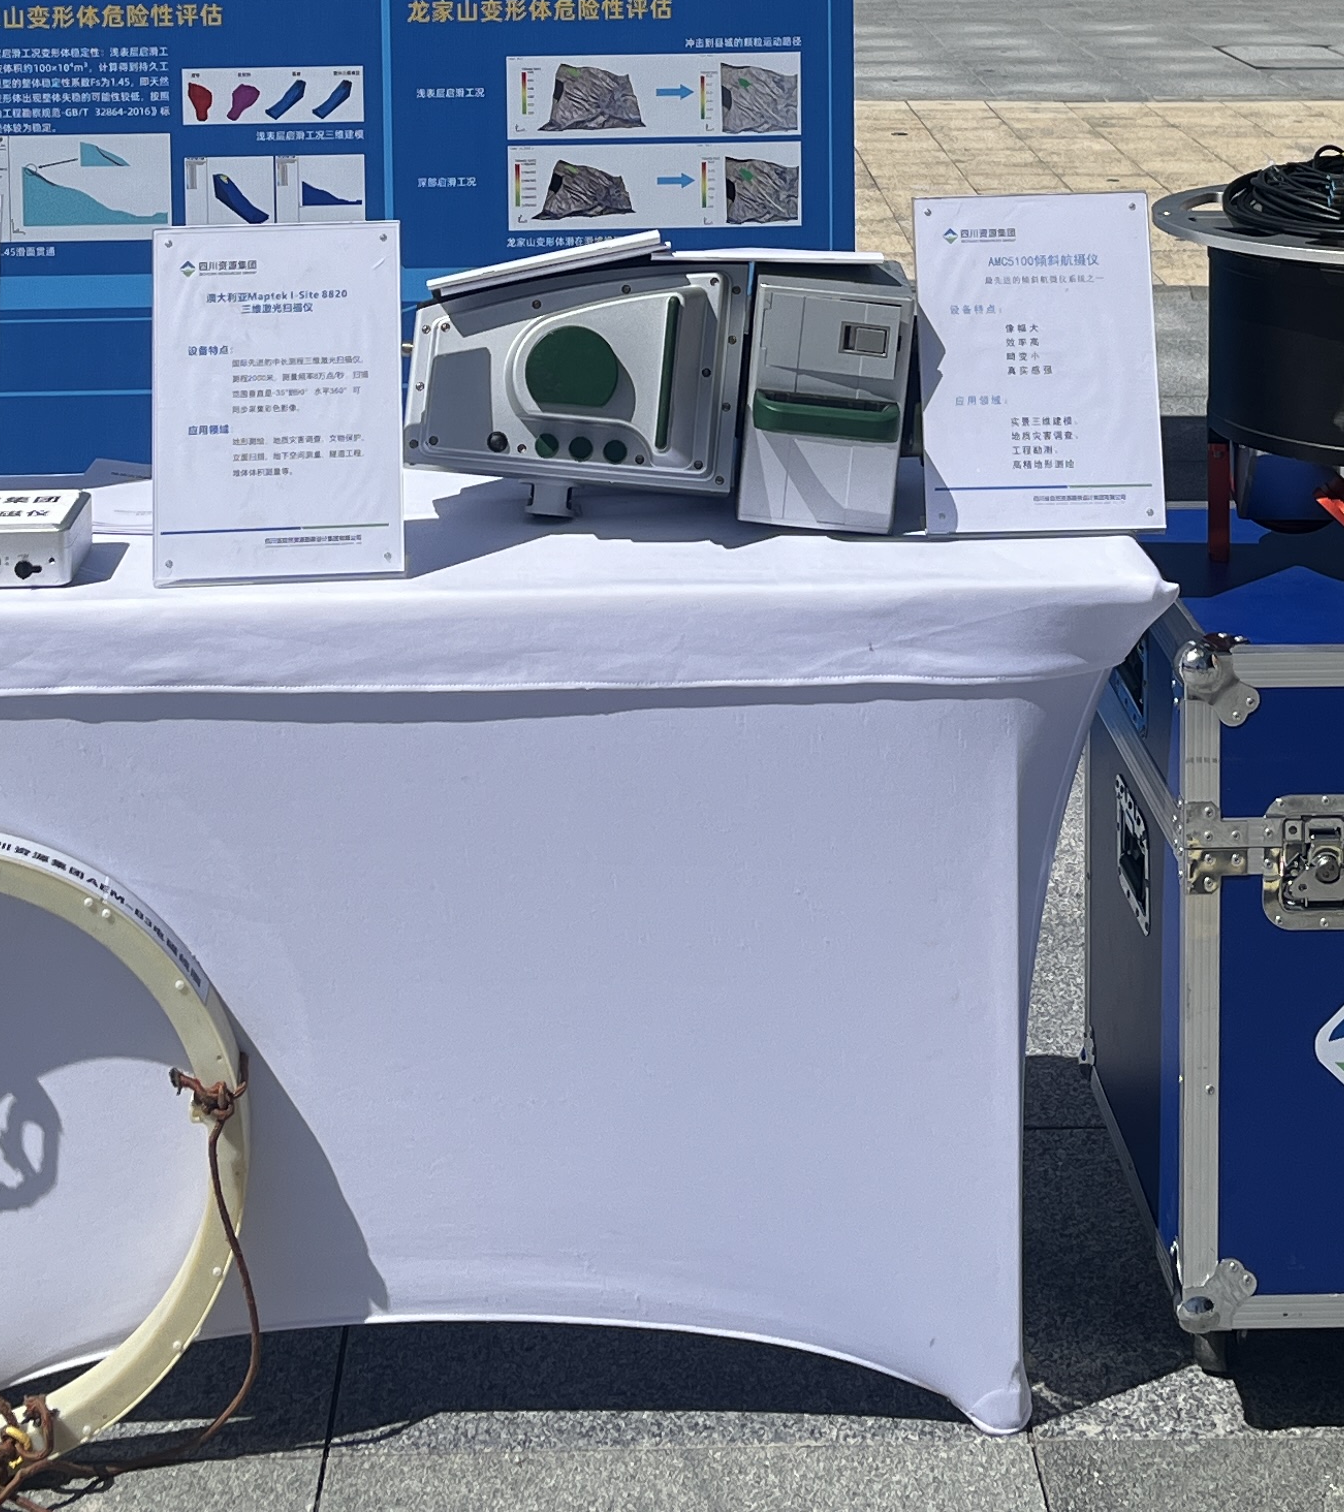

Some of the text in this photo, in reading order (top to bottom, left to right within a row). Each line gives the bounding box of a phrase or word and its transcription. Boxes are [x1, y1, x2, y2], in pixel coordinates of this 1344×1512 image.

[960, 227, 1017, 238] 四川资源集团
[198, 259, 258, 271] 四川资源集团
[987, 253, 1100, 267] AMC5100倾斜航摄仪
[321, 289, 348, 299] 8820
